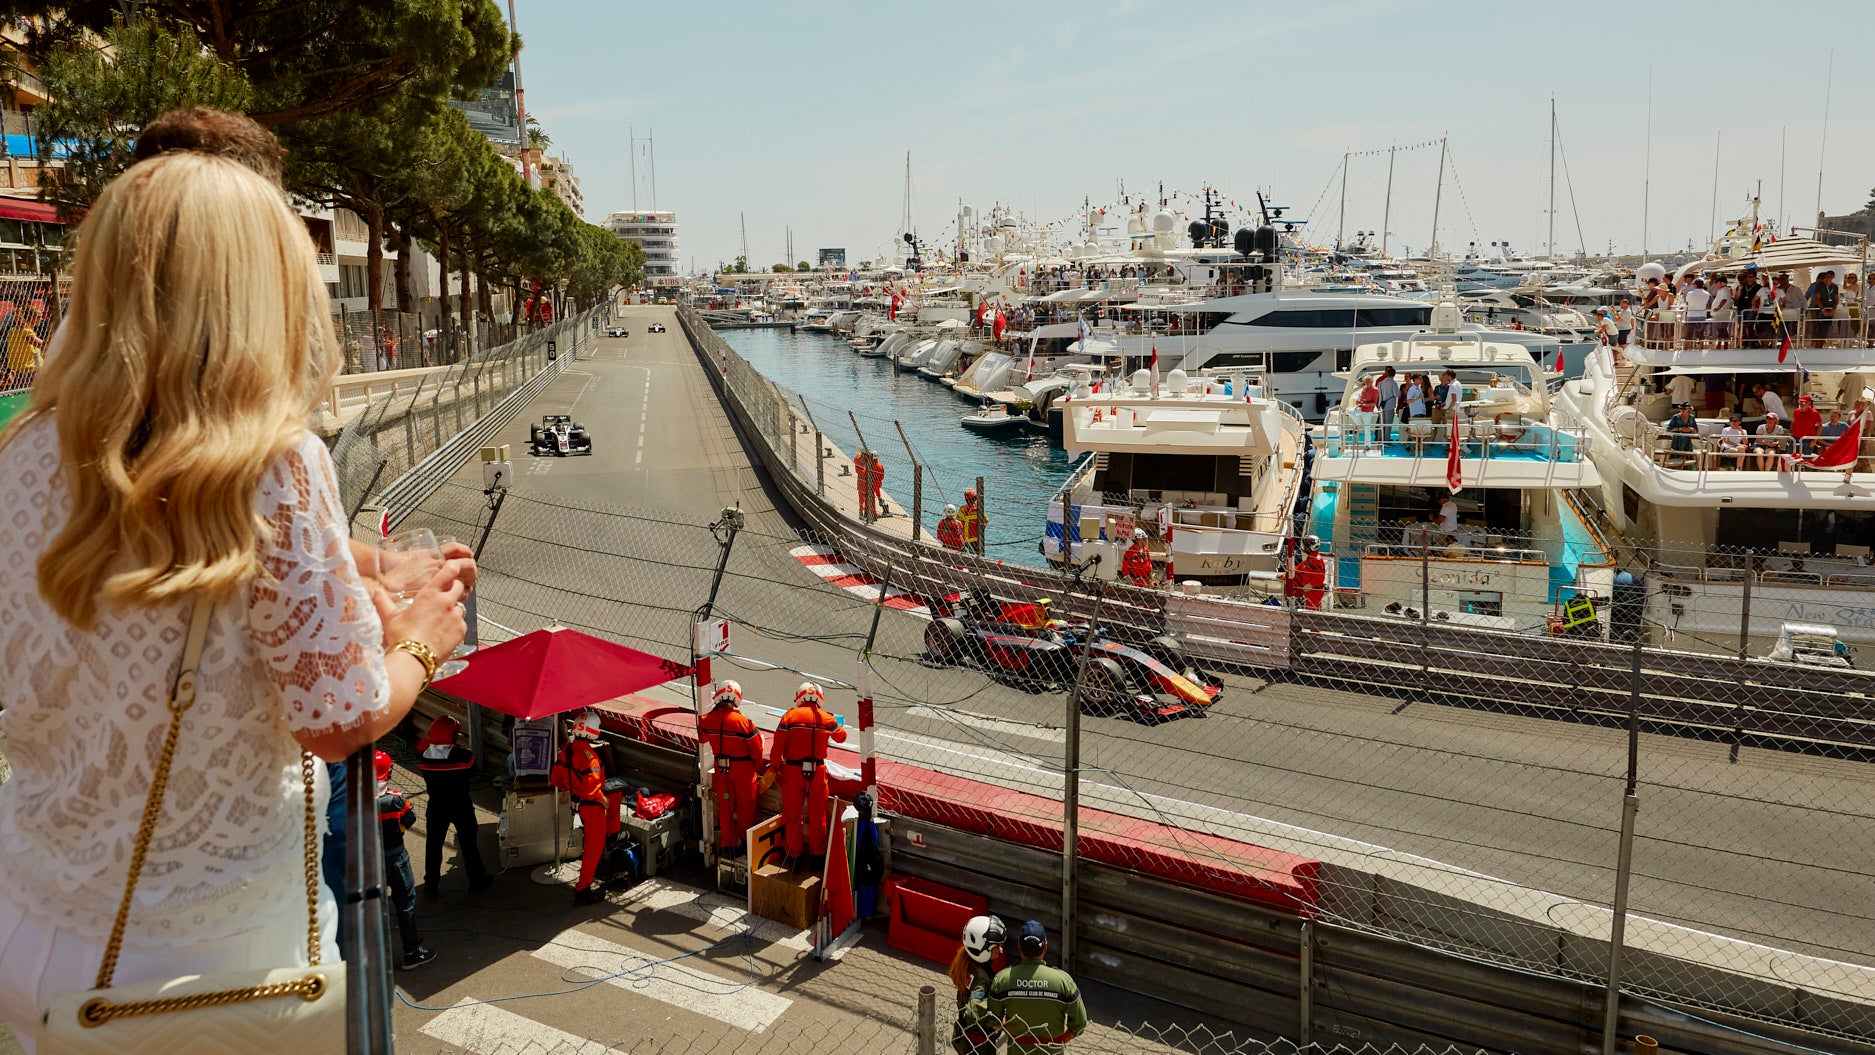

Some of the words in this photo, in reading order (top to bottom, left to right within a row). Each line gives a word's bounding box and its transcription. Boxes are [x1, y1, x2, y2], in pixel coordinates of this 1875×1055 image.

[664, 278, 680, 286] UBS
[1785, 603, 1826, 620] New
[1016, 979, 1049, 988] DOCTOR
[1044, 991, 1058, 999] MONACO
